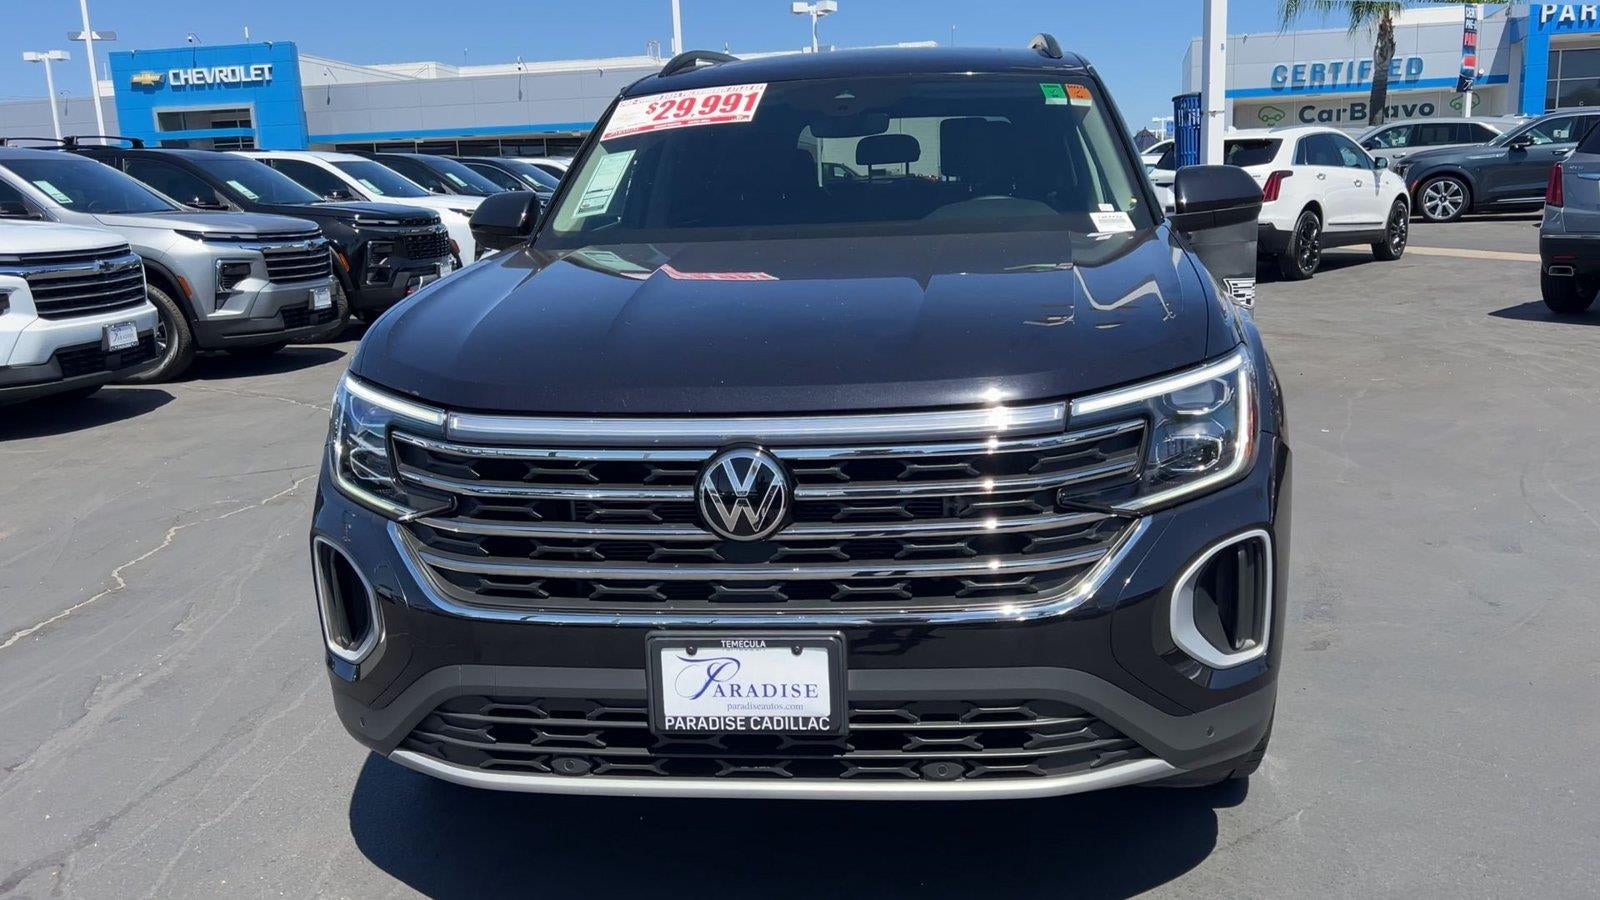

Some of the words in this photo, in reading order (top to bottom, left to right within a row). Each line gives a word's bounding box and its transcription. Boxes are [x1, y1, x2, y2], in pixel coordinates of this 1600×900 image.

[168, 64, 272, 86] CHEVROLET
[1271, 56, 1424, 86] CERTIFED
[1299, 102, 1435, 124] CarBavo
[720, 640, 767, 648] TEMECULA
[675, 655, 819, 700] PARADISE
[727, 701, 804, 711] paradiseautos.com
[665, 716, 746, 731] PARADISE
[750, 716, 830, 731] CADILLAC
